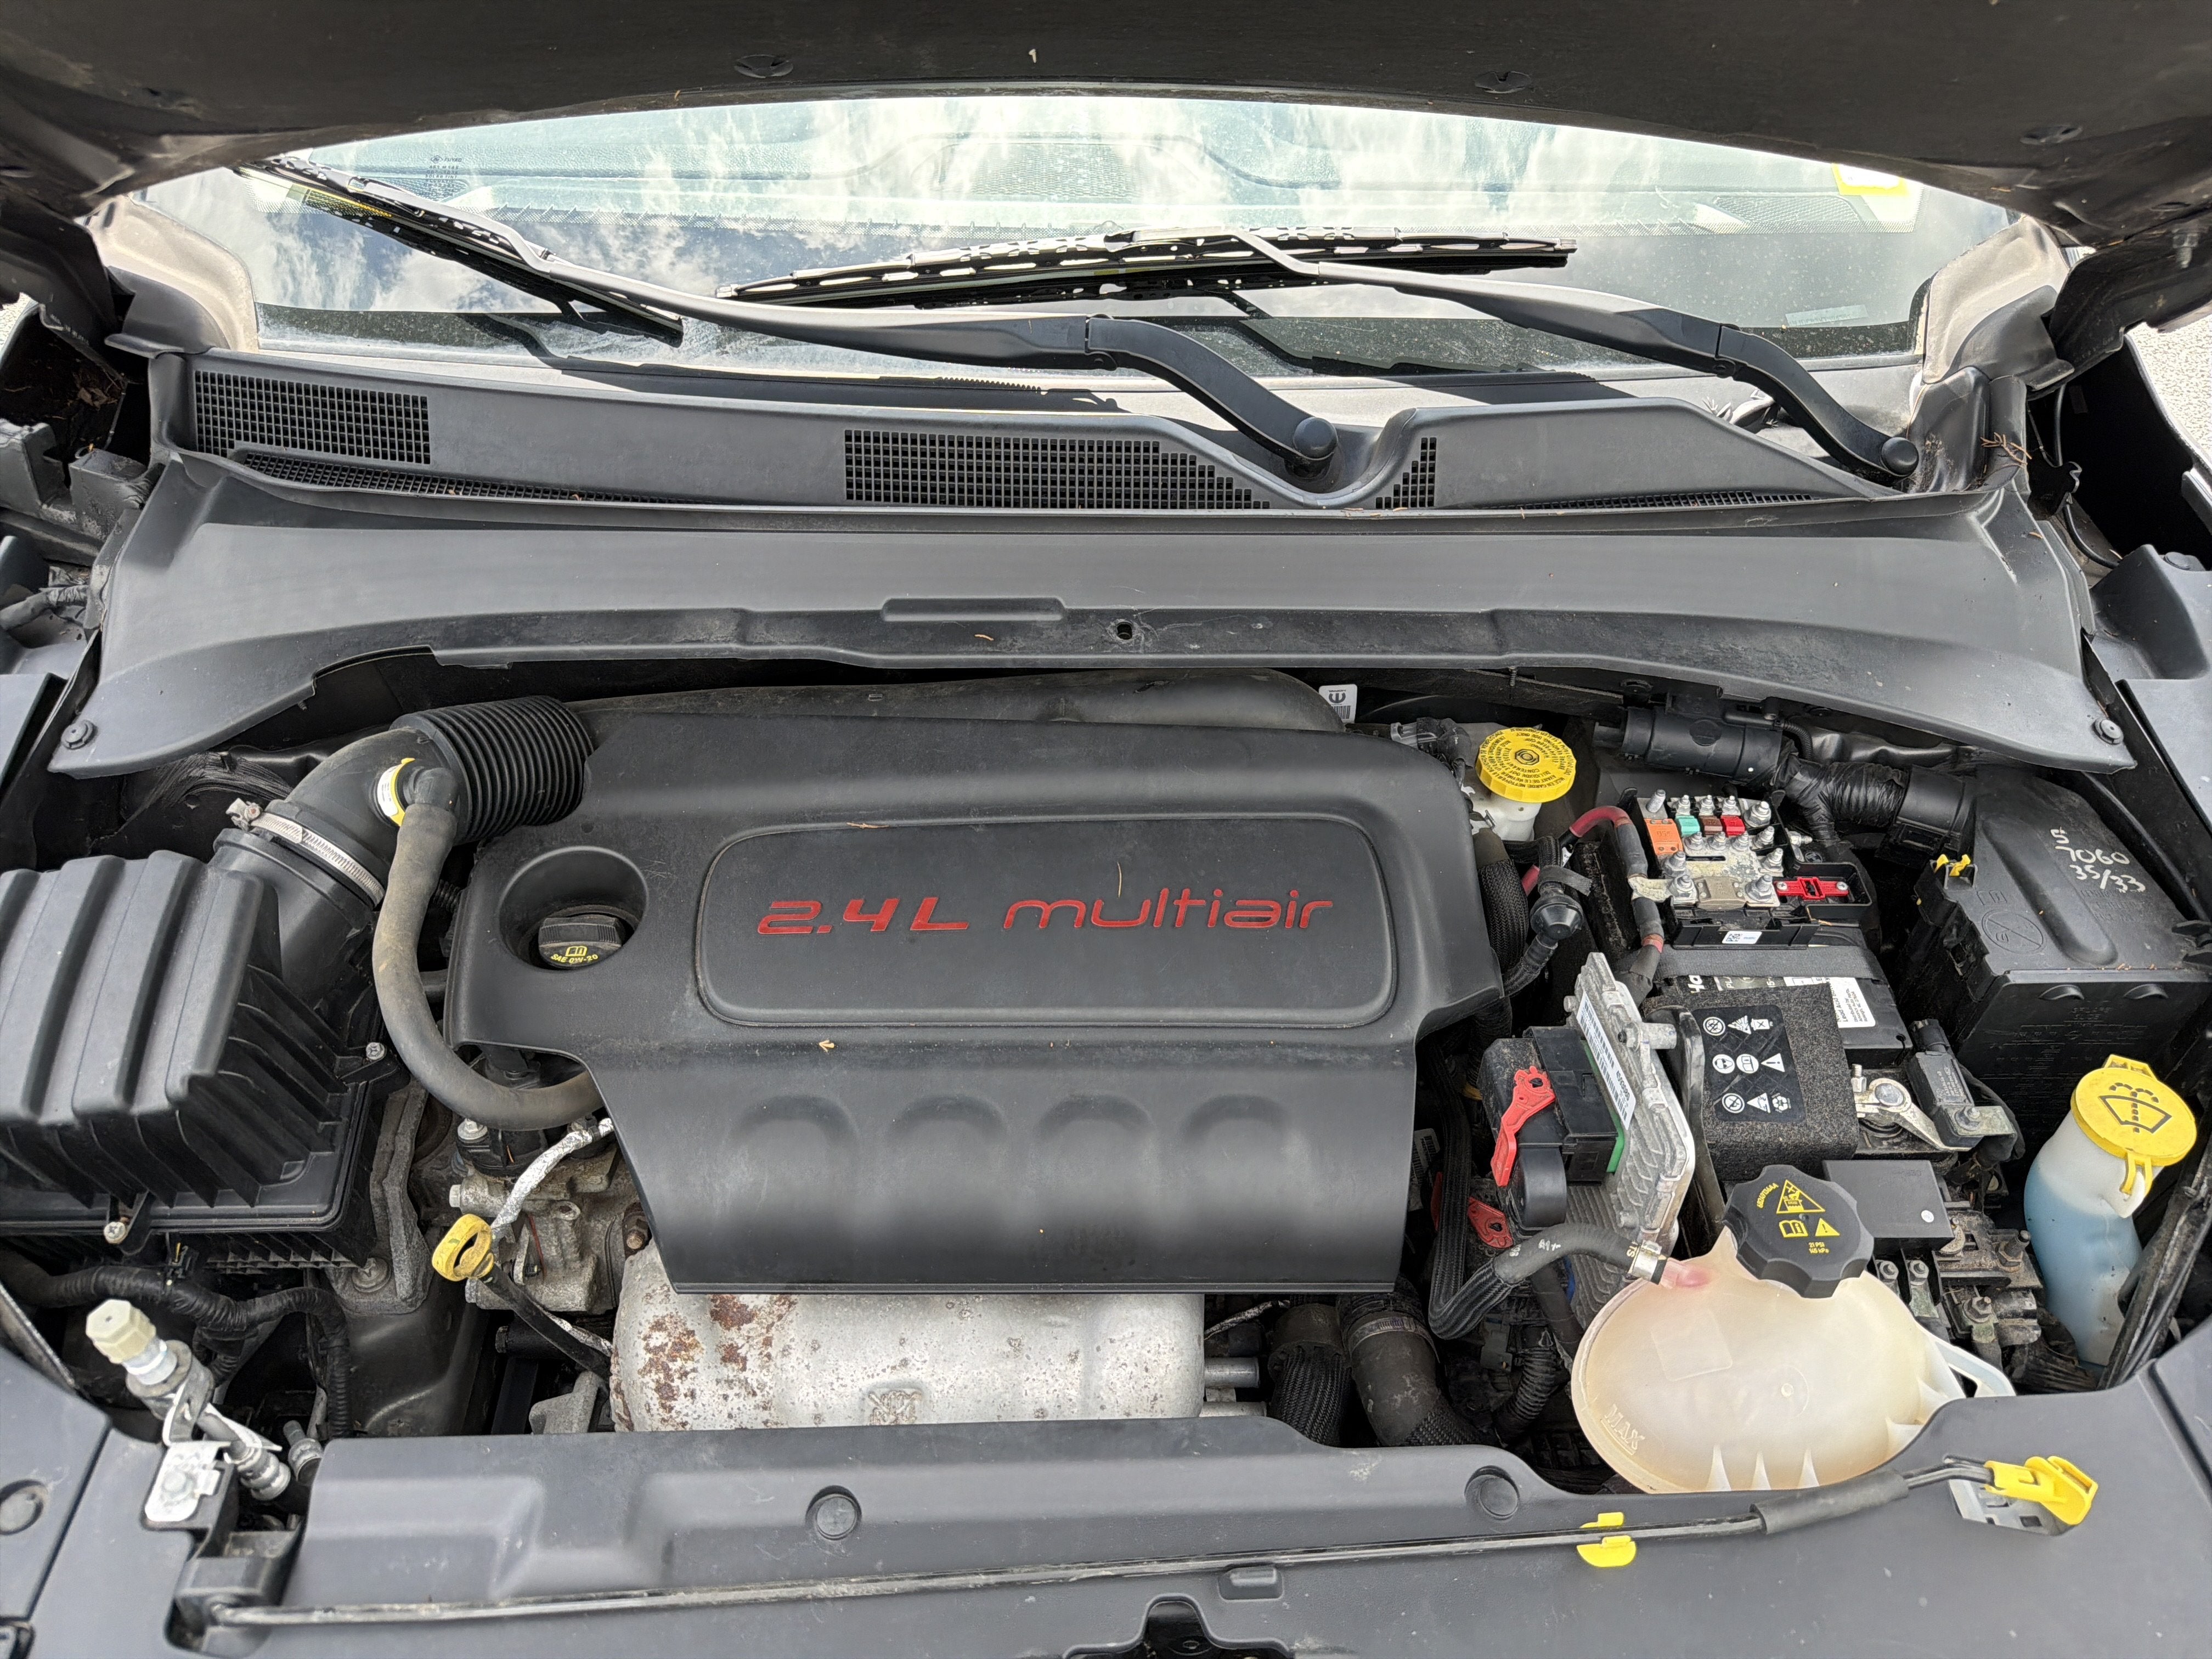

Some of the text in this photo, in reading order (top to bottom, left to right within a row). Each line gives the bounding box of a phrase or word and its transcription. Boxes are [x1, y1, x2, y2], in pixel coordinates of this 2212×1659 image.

[1496, 775, 1526, 787] NETTOYER
[1540, 774, 1557, 782] AVANT
[2055, 845, 2130, 865] 7060
[2070, 865, 2146, 893] 35/33
[1004, 888, 1332, 929] multiair
[551, 953, 599, 964] SAE 0W-20
[1604, 1403, 1645, 1451] MAX
